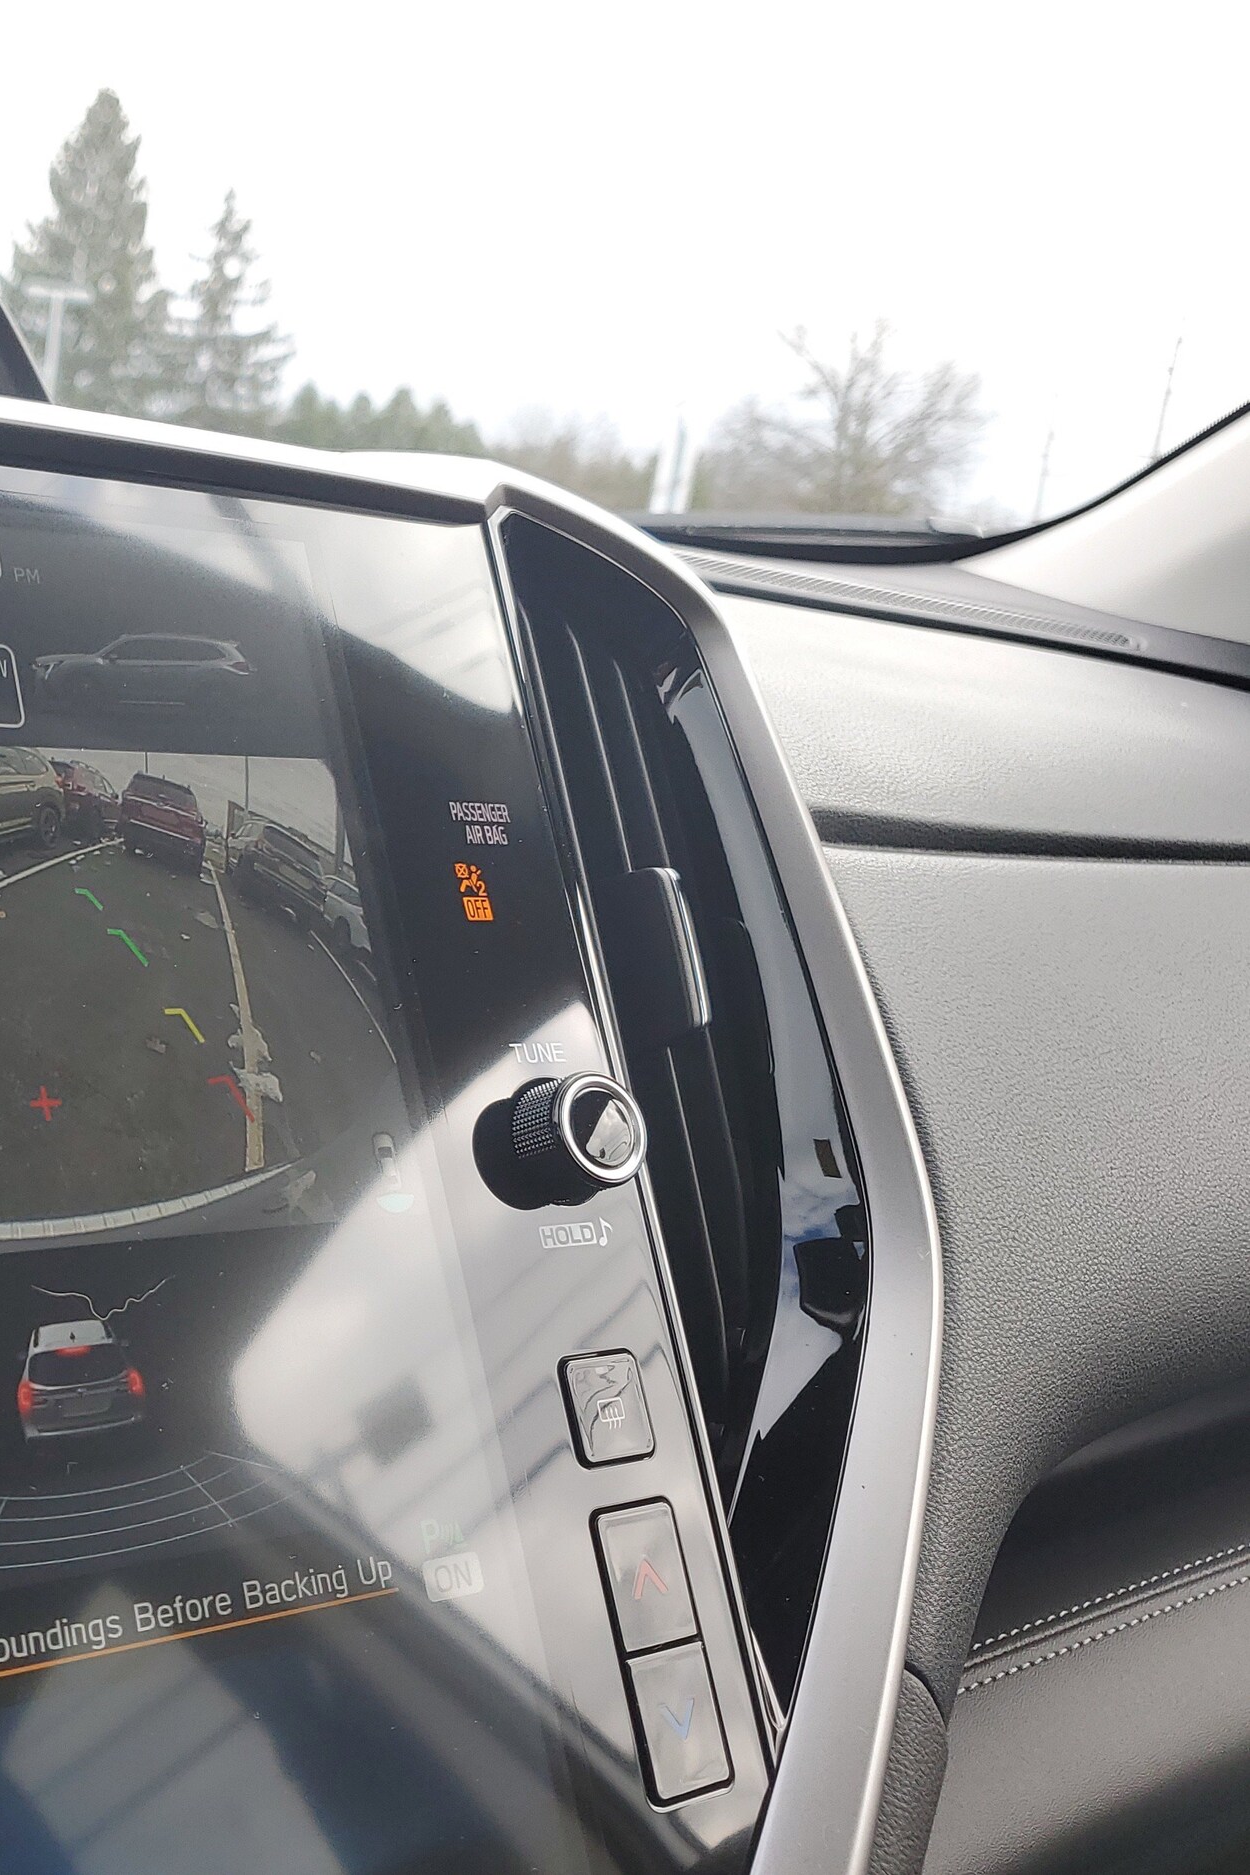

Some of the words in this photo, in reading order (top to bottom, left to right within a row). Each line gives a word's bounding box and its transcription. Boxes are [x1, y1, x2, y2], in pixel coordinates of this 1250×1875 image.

[13, 567, 40, 585] PM
[449, 801, 511, 823] PASSENGER
[466, 825, 485, 845] AIR
[484, 825, 508, 845] BAG
[466, 899, 489, 919] OFF
[508, 1042, 566, 1064] TUNE
[542, 1223, 595, 1248] HOLD
[435, 1561, 473, 1593] ON
[135, 1591, 232, 1634] Before
[244, 1560, 349, 1612] Backing
[357, 1557, 393, 1590] Up
